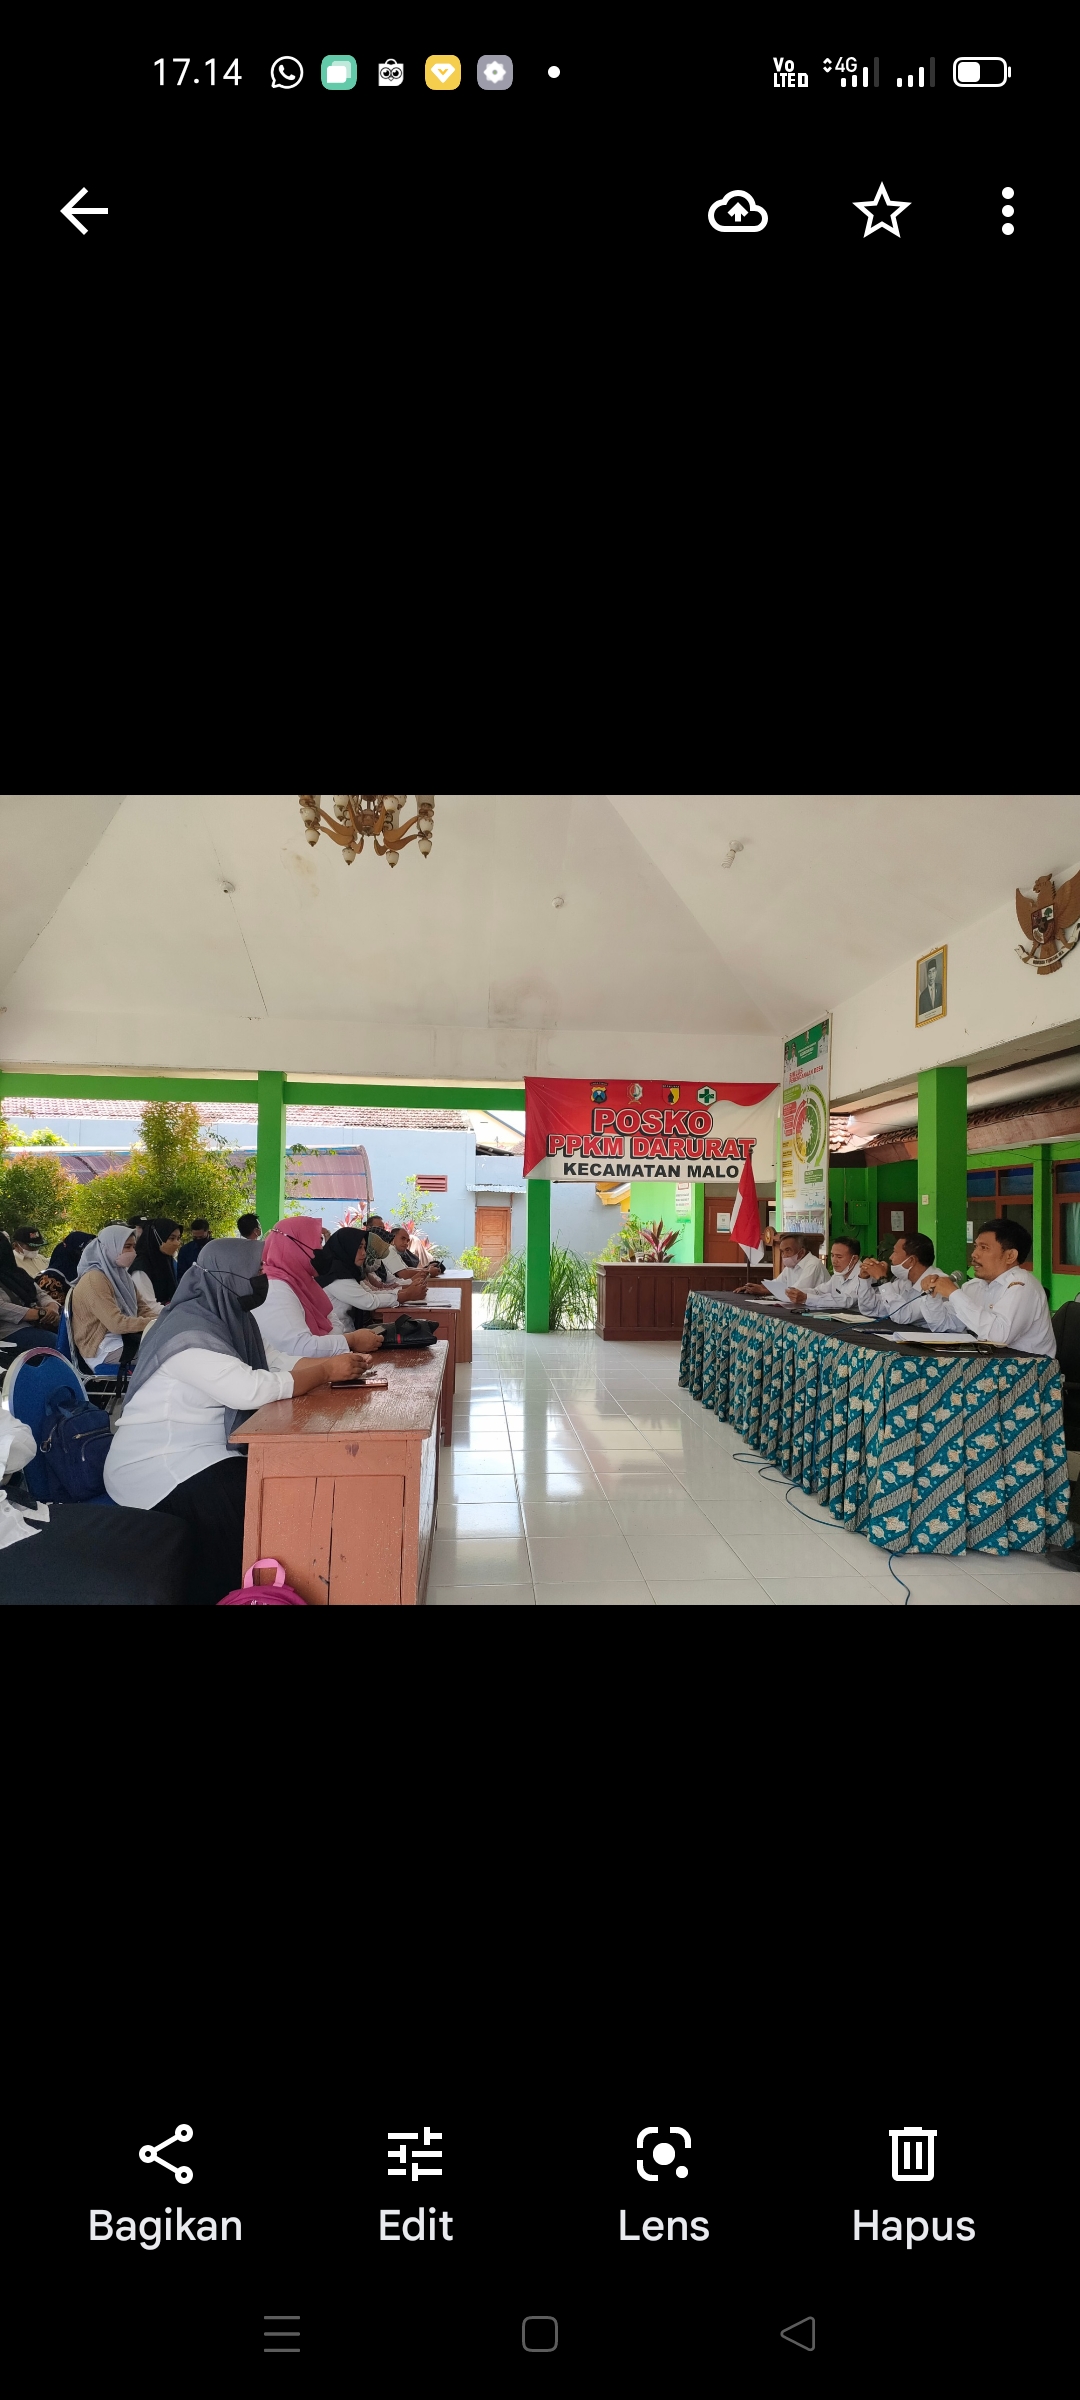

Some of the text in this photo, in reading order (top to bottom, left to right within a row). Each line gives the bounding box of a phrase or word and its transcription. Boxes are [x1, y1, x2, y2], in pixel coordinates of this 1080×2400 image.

[592, 1107, 714, 1137] POSKO
[547, 1134, 757, 1160] PPKM DARURAT
[563, 1162, 739, 1178] KECAMATAN MALO
